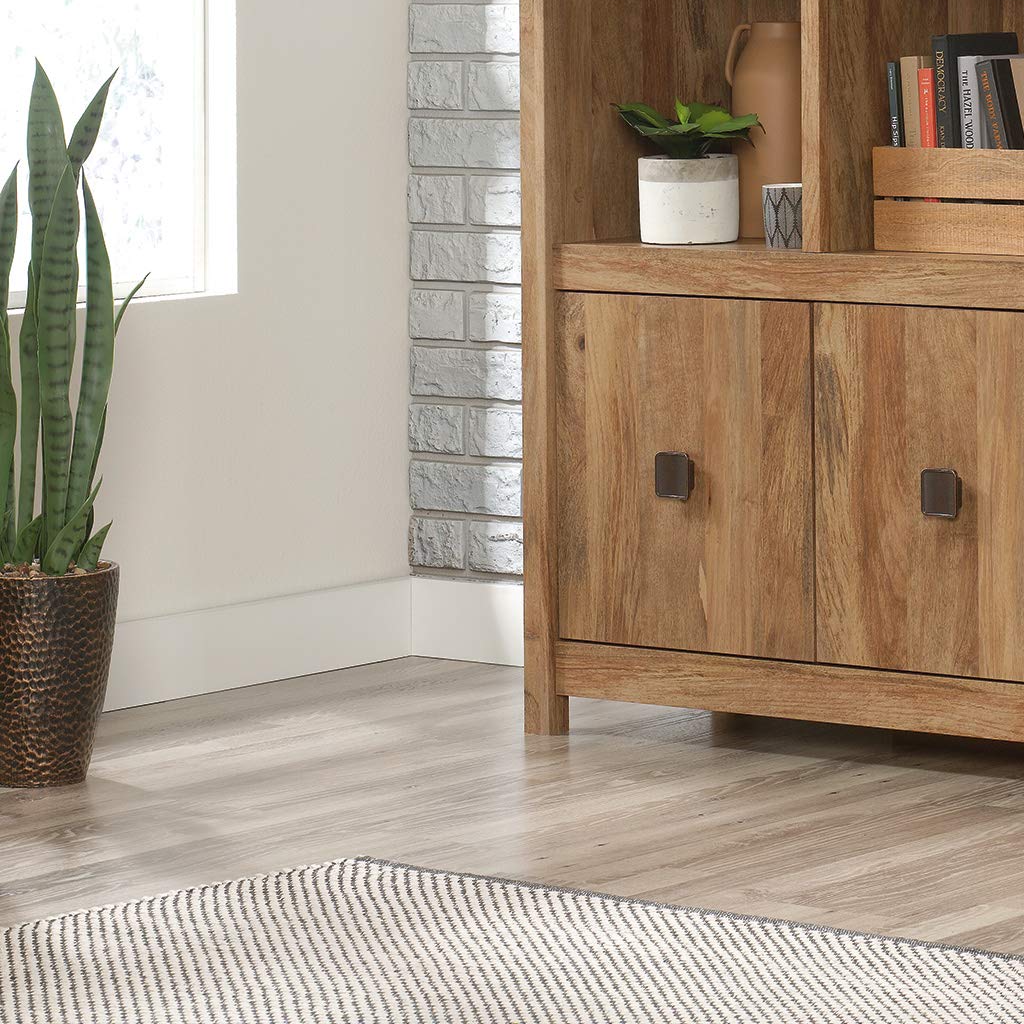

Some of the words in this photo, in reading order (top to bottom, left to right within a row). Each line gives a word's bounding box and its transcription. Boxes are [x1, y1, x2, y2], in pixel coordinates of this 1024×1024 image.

[936, 51, 947, 113] DEMOCRACY
[963, 89, 972, 119] HAZEL
[965, 120, 974, 150] WOOD
